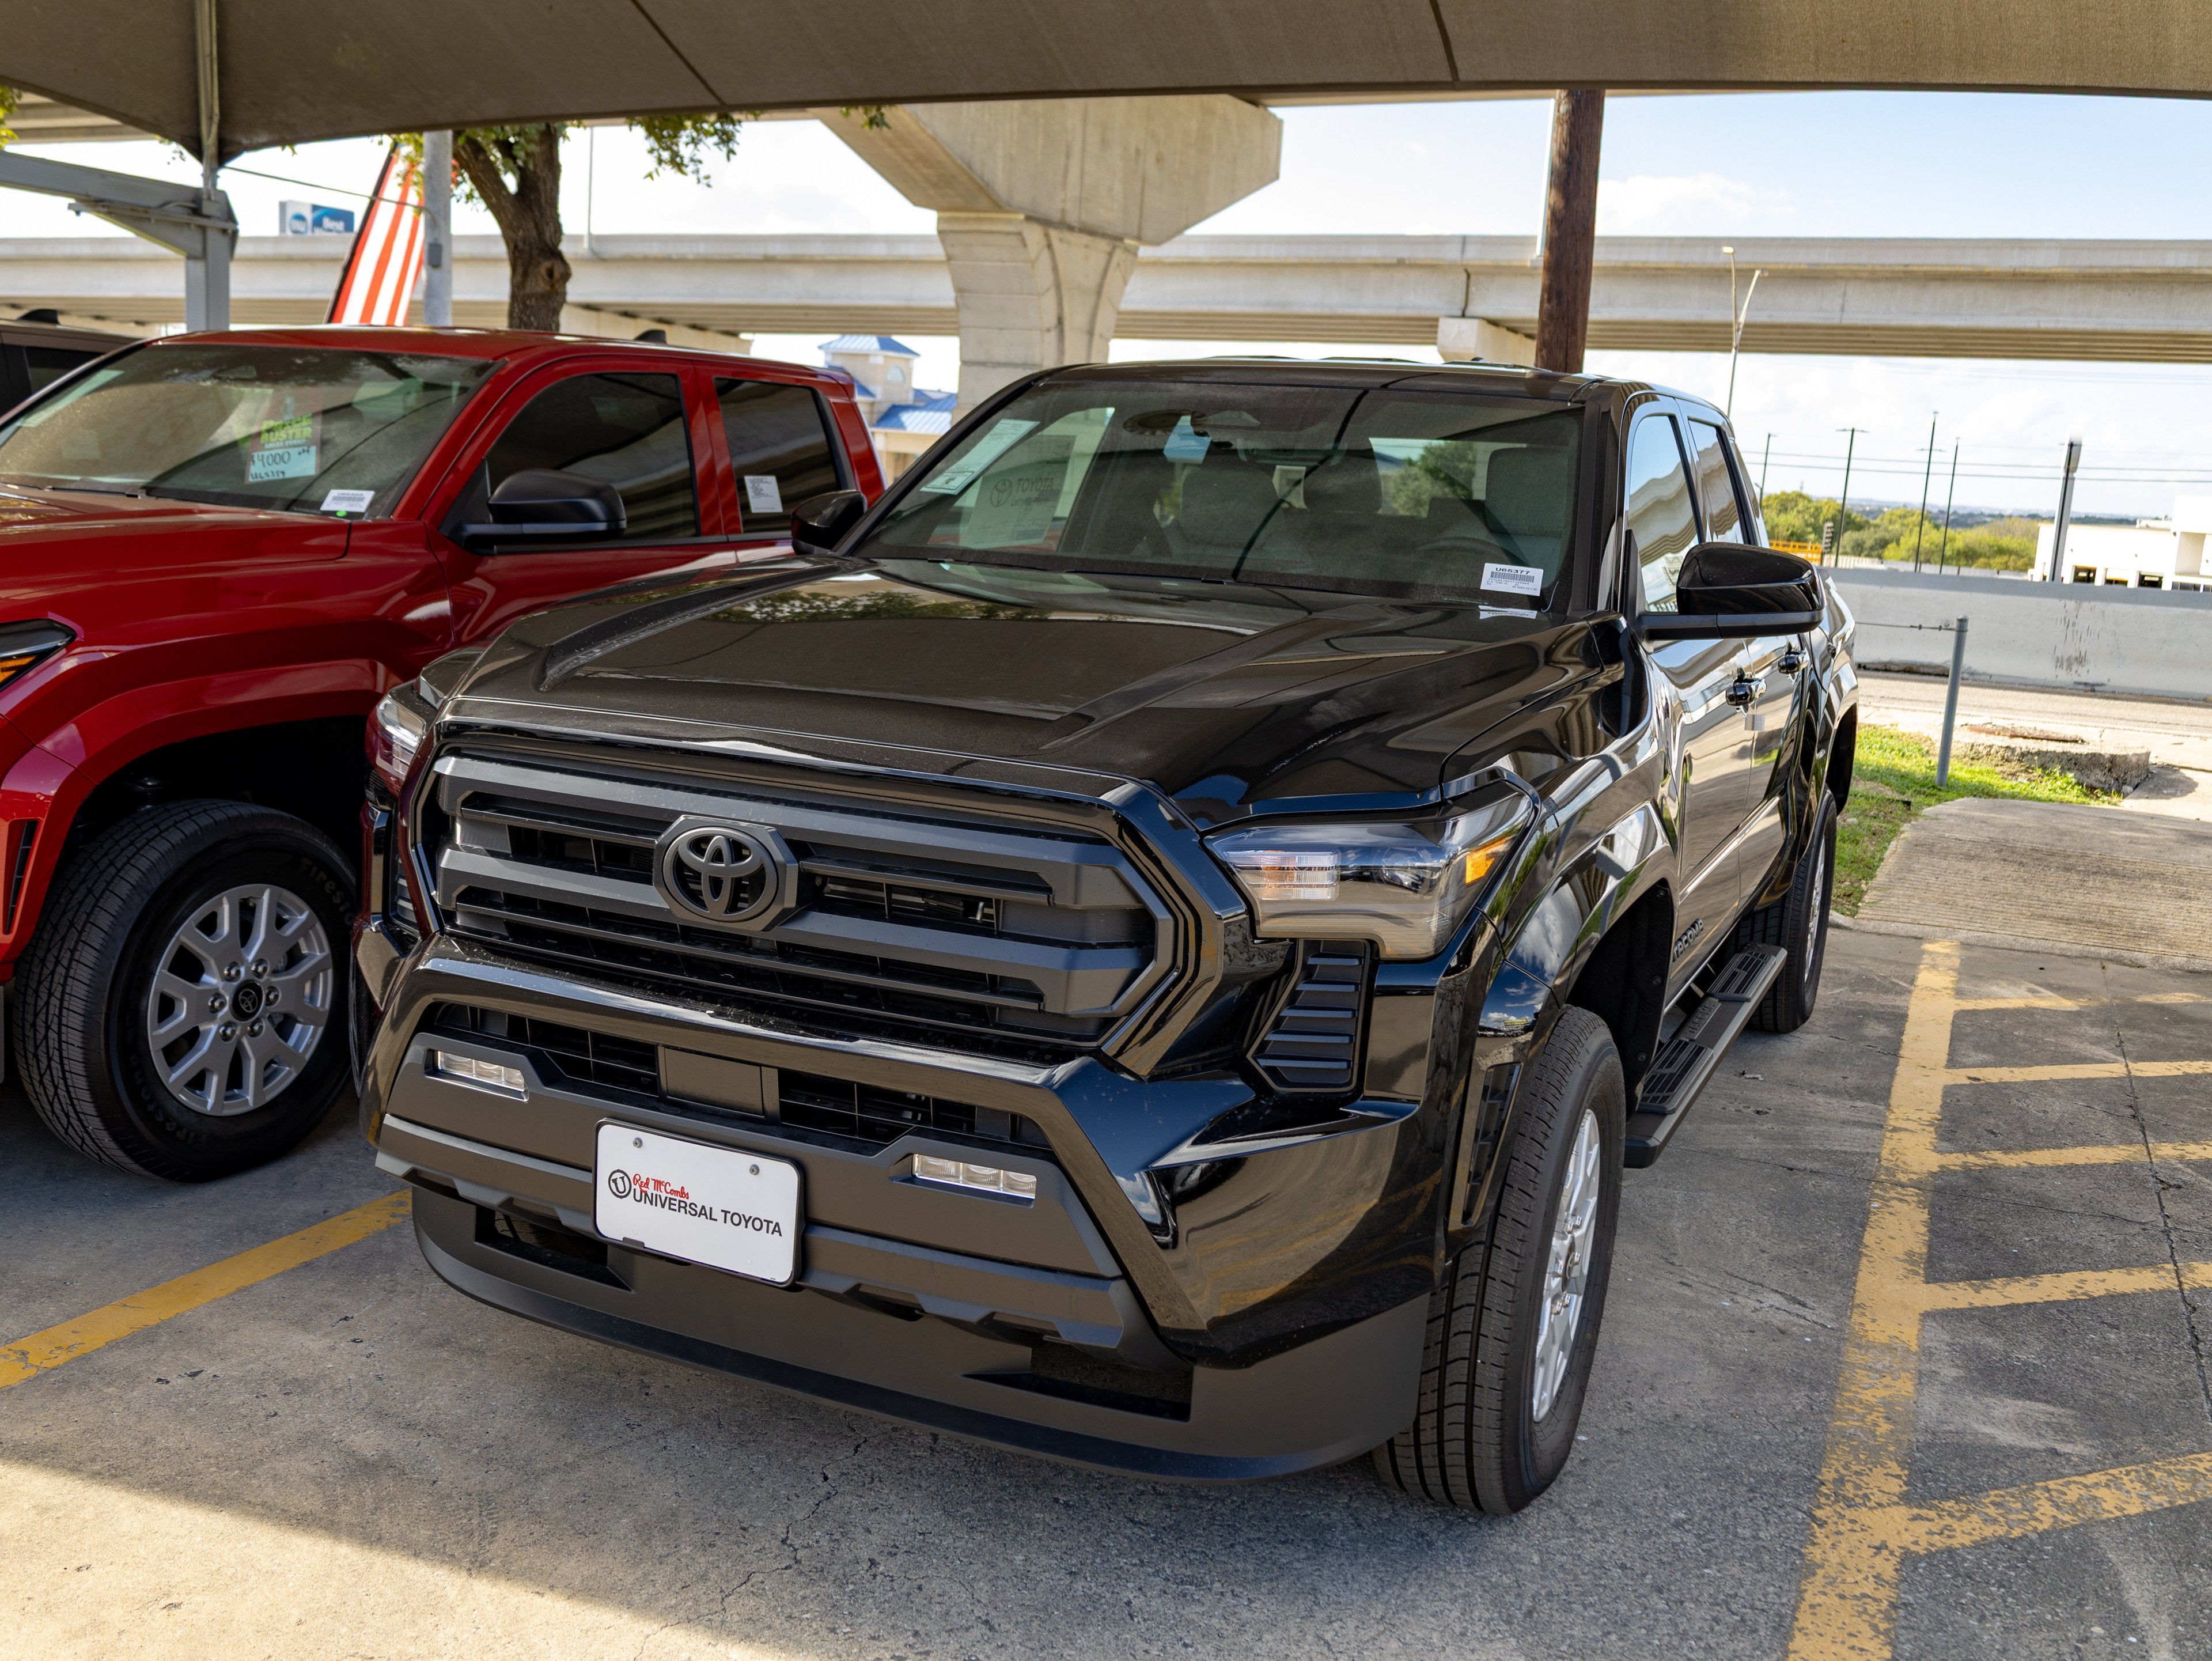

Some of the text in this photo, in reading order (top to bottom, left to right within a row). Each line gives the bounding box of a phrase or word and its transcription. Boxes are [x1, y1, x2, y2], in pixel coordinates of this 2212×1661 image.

[260, 427, 312, 444] BUSTER
[250, 451, 290, 467] $4000
[1016, 477, 1054, 493] TOYOTA
[1672, 918, 1704, 963] TACOMA
[611, 1176, 626, 1195] U
[633, 1174, 690, 1200] Red McCombs
[632, 1188, 783, 1237] UNIVERSAL TOYOTA
